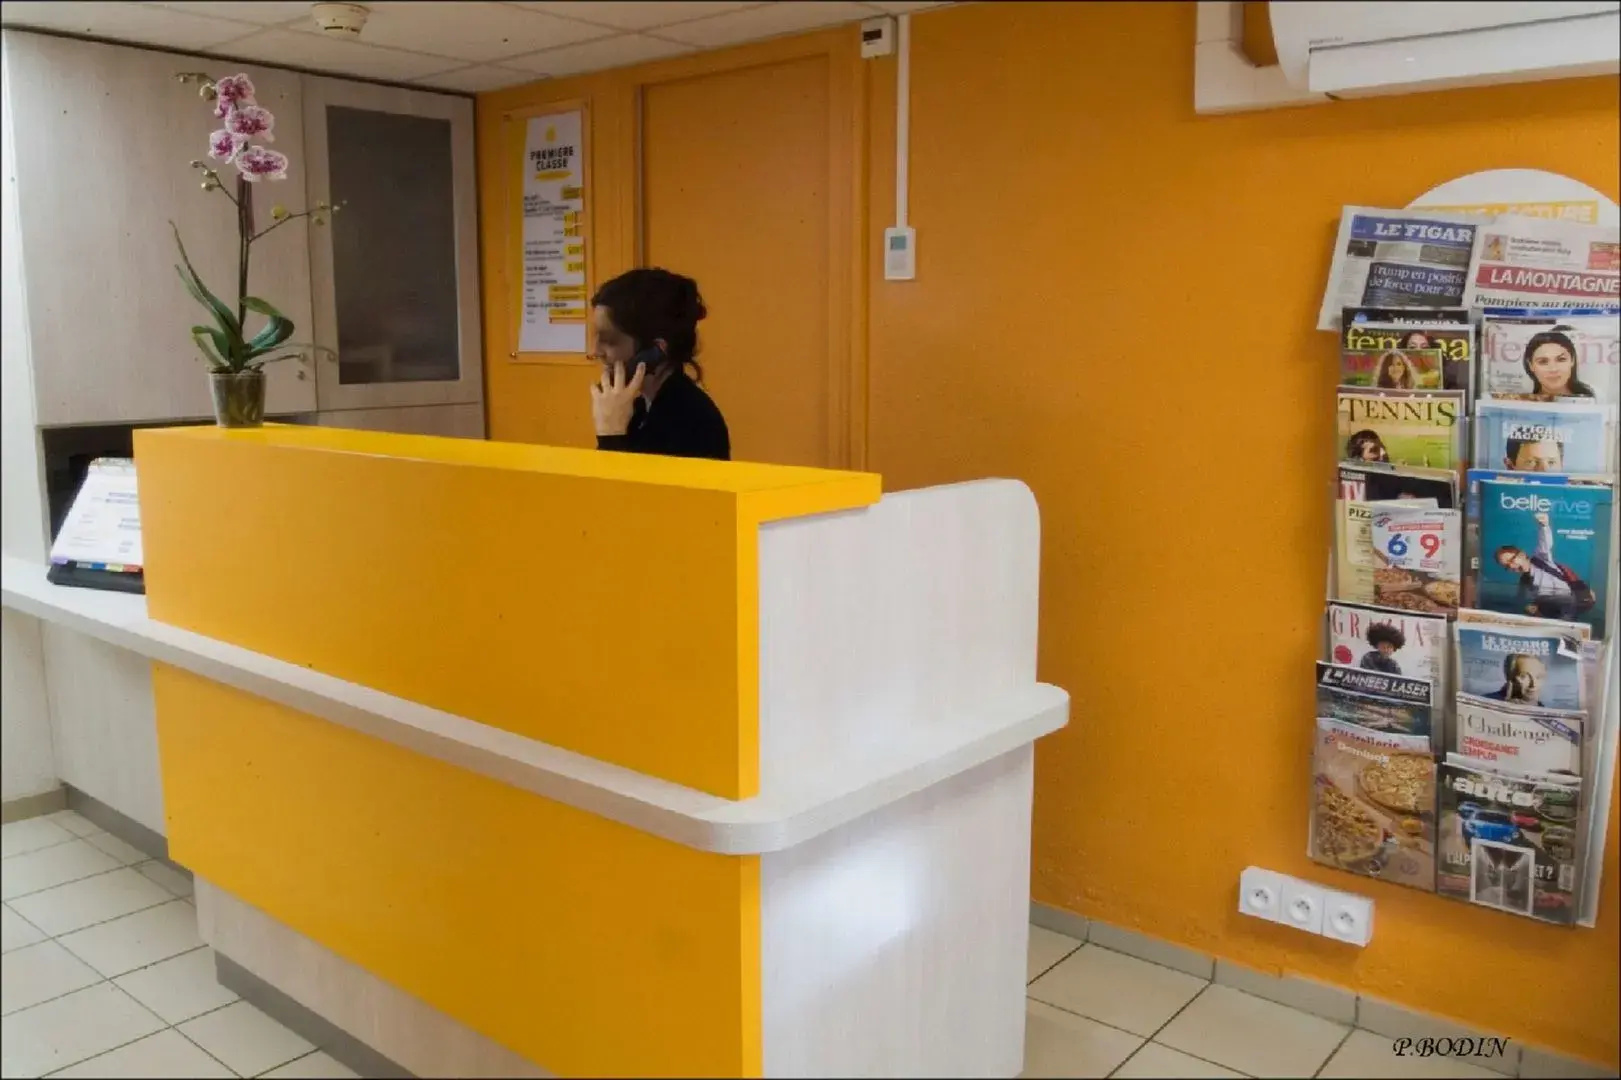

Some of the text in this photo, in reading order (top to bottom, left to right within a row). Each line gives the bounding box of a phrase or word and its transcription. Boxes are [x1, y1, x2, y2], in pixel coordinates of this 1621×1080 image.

[536, 157, 568, 171] CLASSE
[1374, 222, 1473, 242] LE FIGAR
[1373, 265, 1411, 280] Trump
[1411, 271, 1426, 280] en
[1490, 268, 1619, 293] LA MONTAGNE
[1369, 277, 1383, 288] de
[1384, 277, 1413, 292] force
[1414, 284, 1444, 295] pour
[1346, 326, 1470, 361] femna
[1340, 398, 1456, 427] TENNIS
[1500, 492, 1592, 514] bellerive
[1348, 508, 1372, 519] PIZZ
[1332, 608, 1424, 647] GRIA
[1391, 681, 1430, 697] LASER
